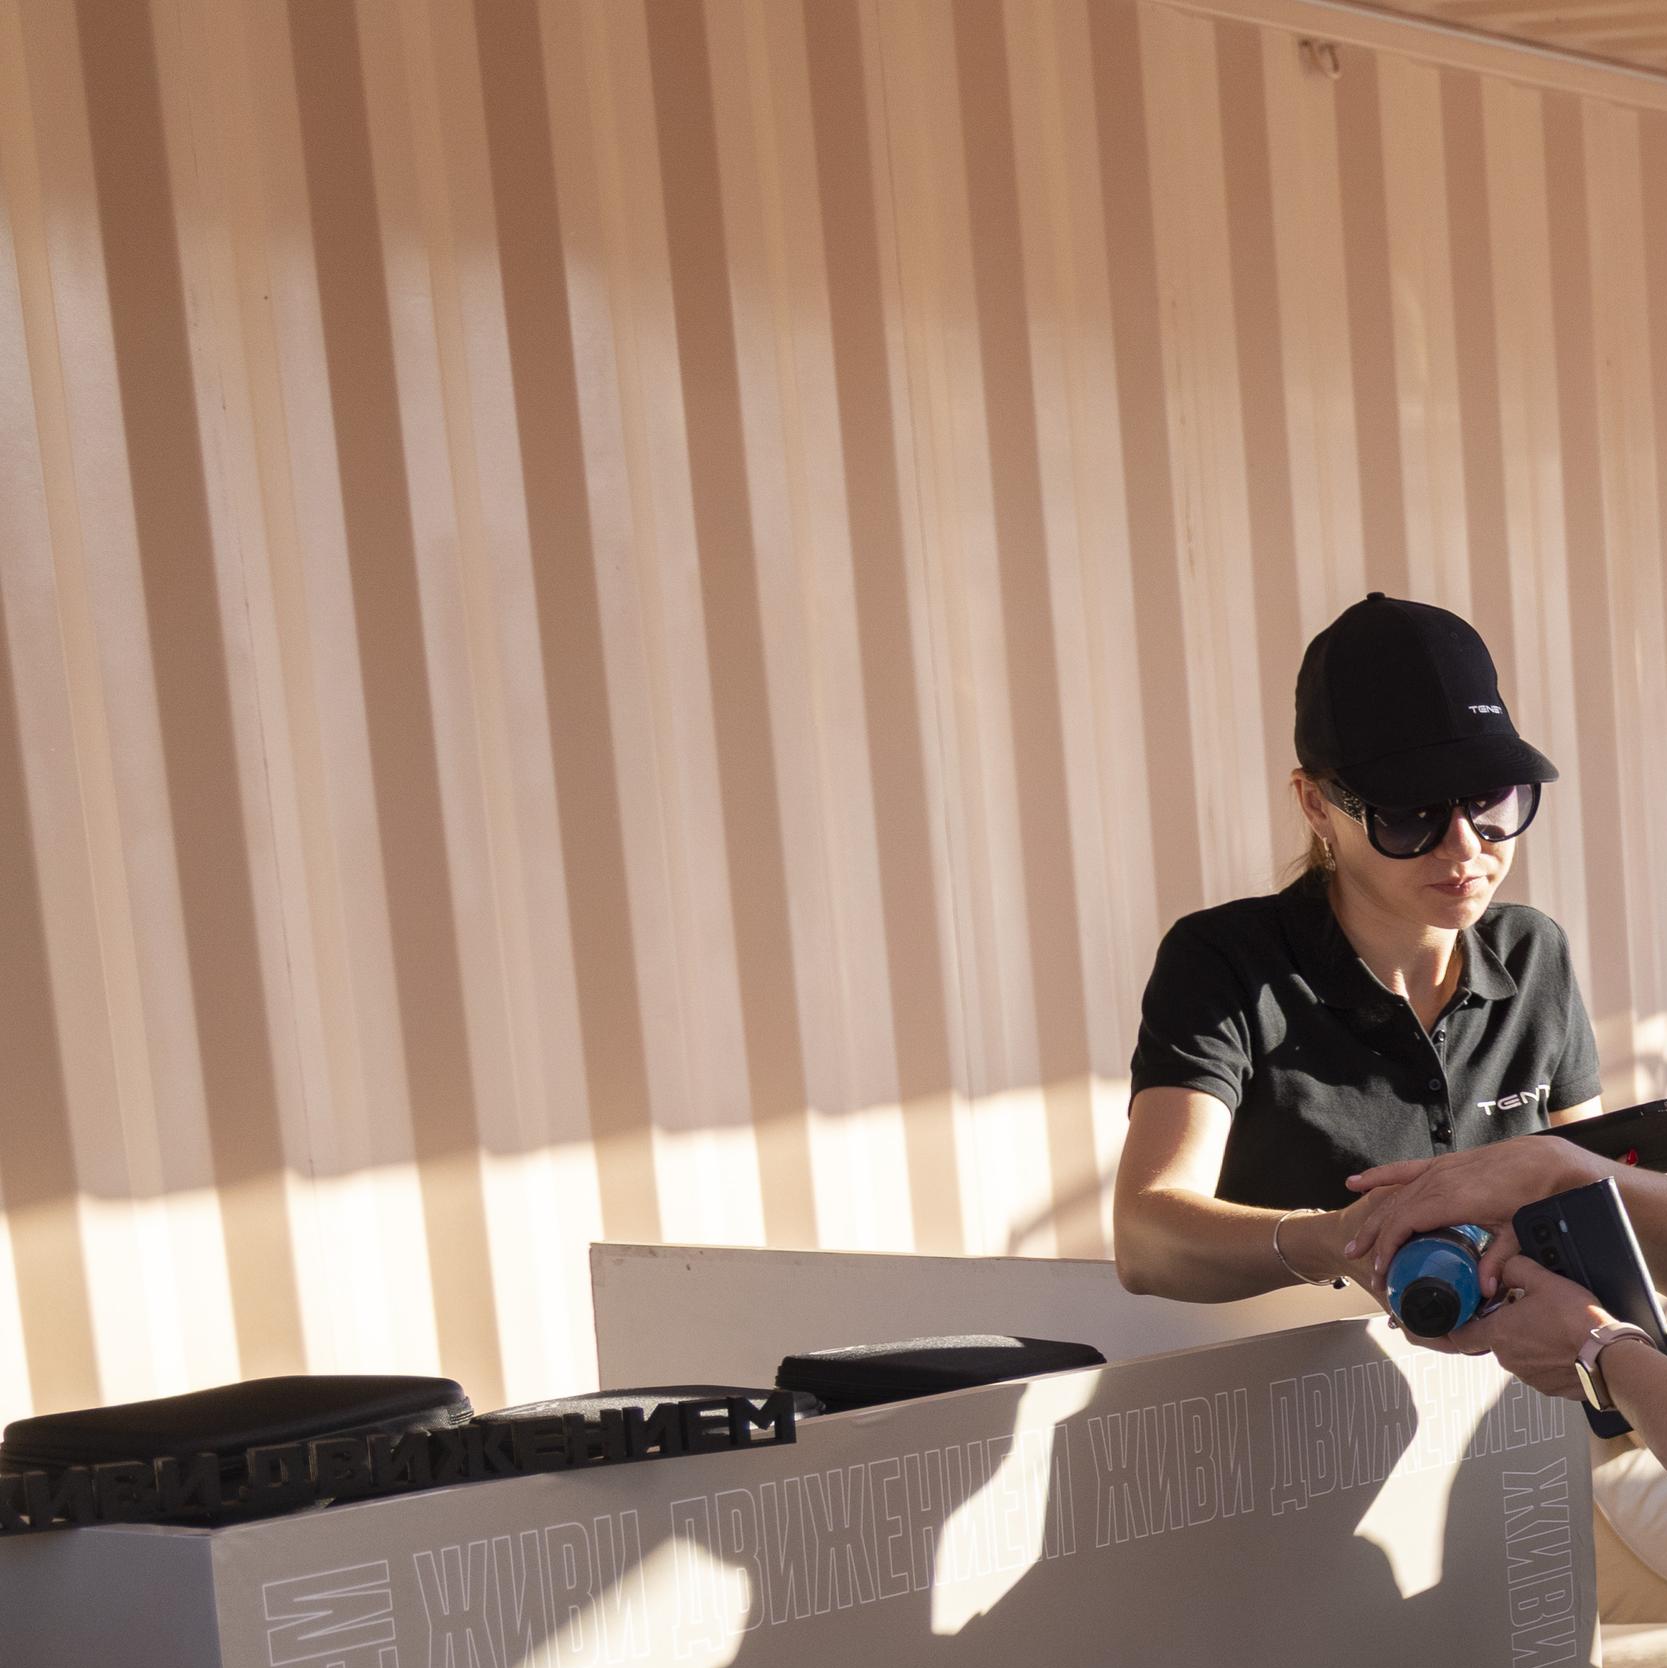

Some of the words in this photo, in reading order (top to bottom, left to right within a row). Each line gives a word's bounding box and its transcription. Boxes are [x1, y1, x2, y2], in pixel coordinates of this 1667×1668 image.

[1477, 1084, 1550, 1116] TENT
[239, 1390, 797, 1508] ДВИЖЕНИЕМ
[671, 1423, 1077, 1660] ДВИЖЕНИЕМ
[1088, 1388, 1254, 1548] ЖИВИ
